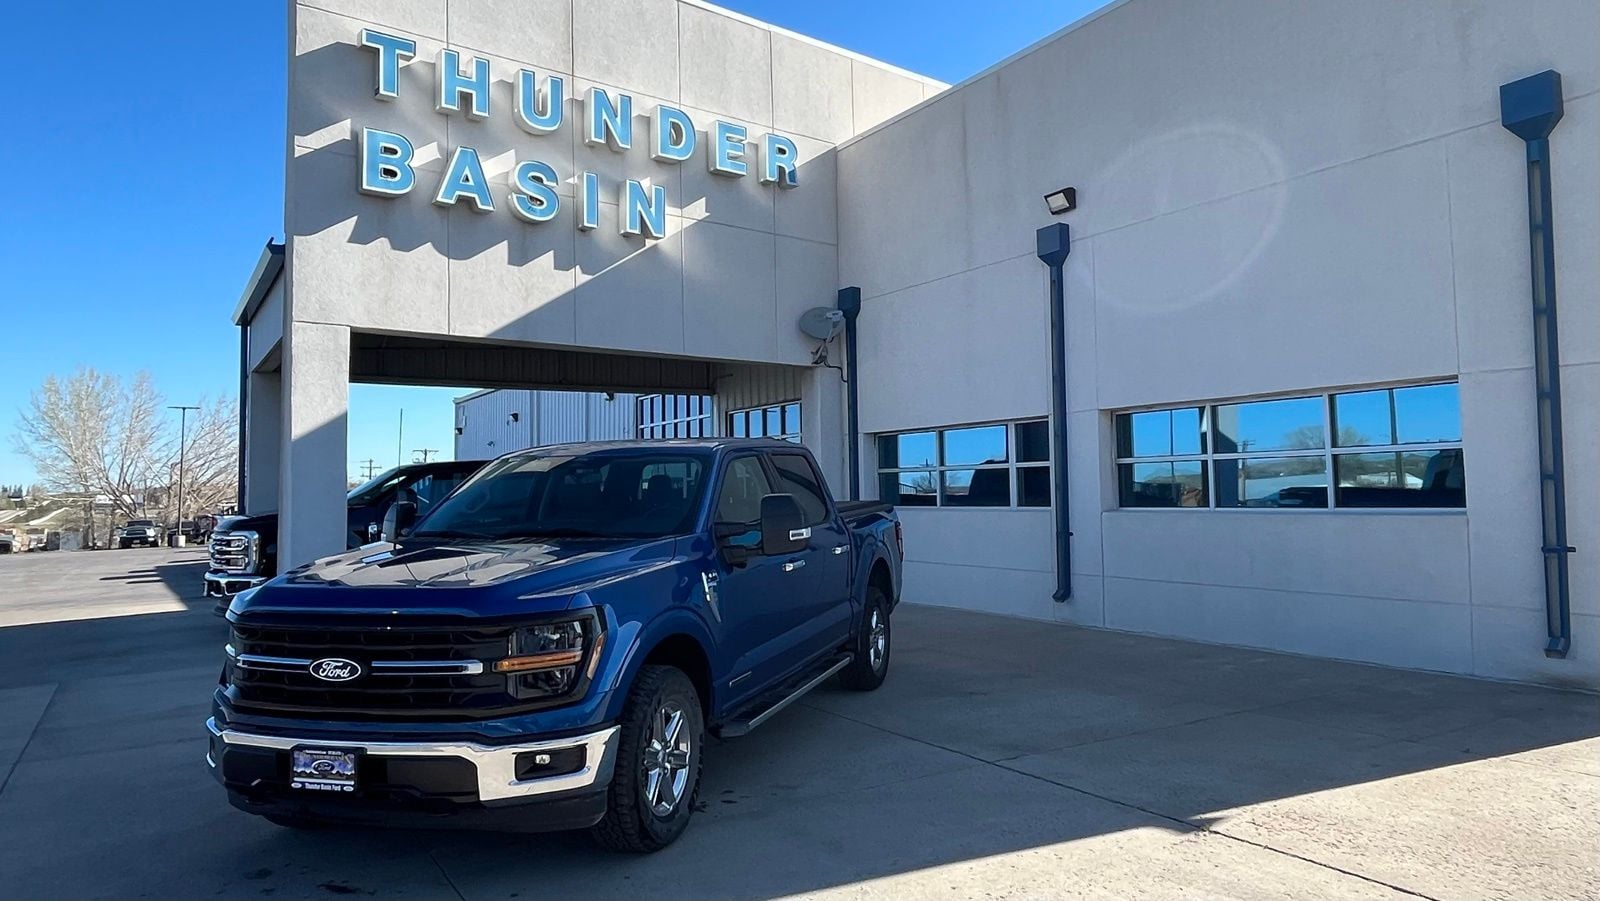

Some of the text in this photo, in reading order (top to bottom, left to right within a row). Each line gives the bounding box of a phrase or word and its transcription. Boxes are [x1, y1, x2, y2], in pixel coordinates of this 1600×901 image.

[358, 28, 799, 189] THUNDER
[358, 126, 666, 240] BASIN
[319, 661, 351, 677] Ford
